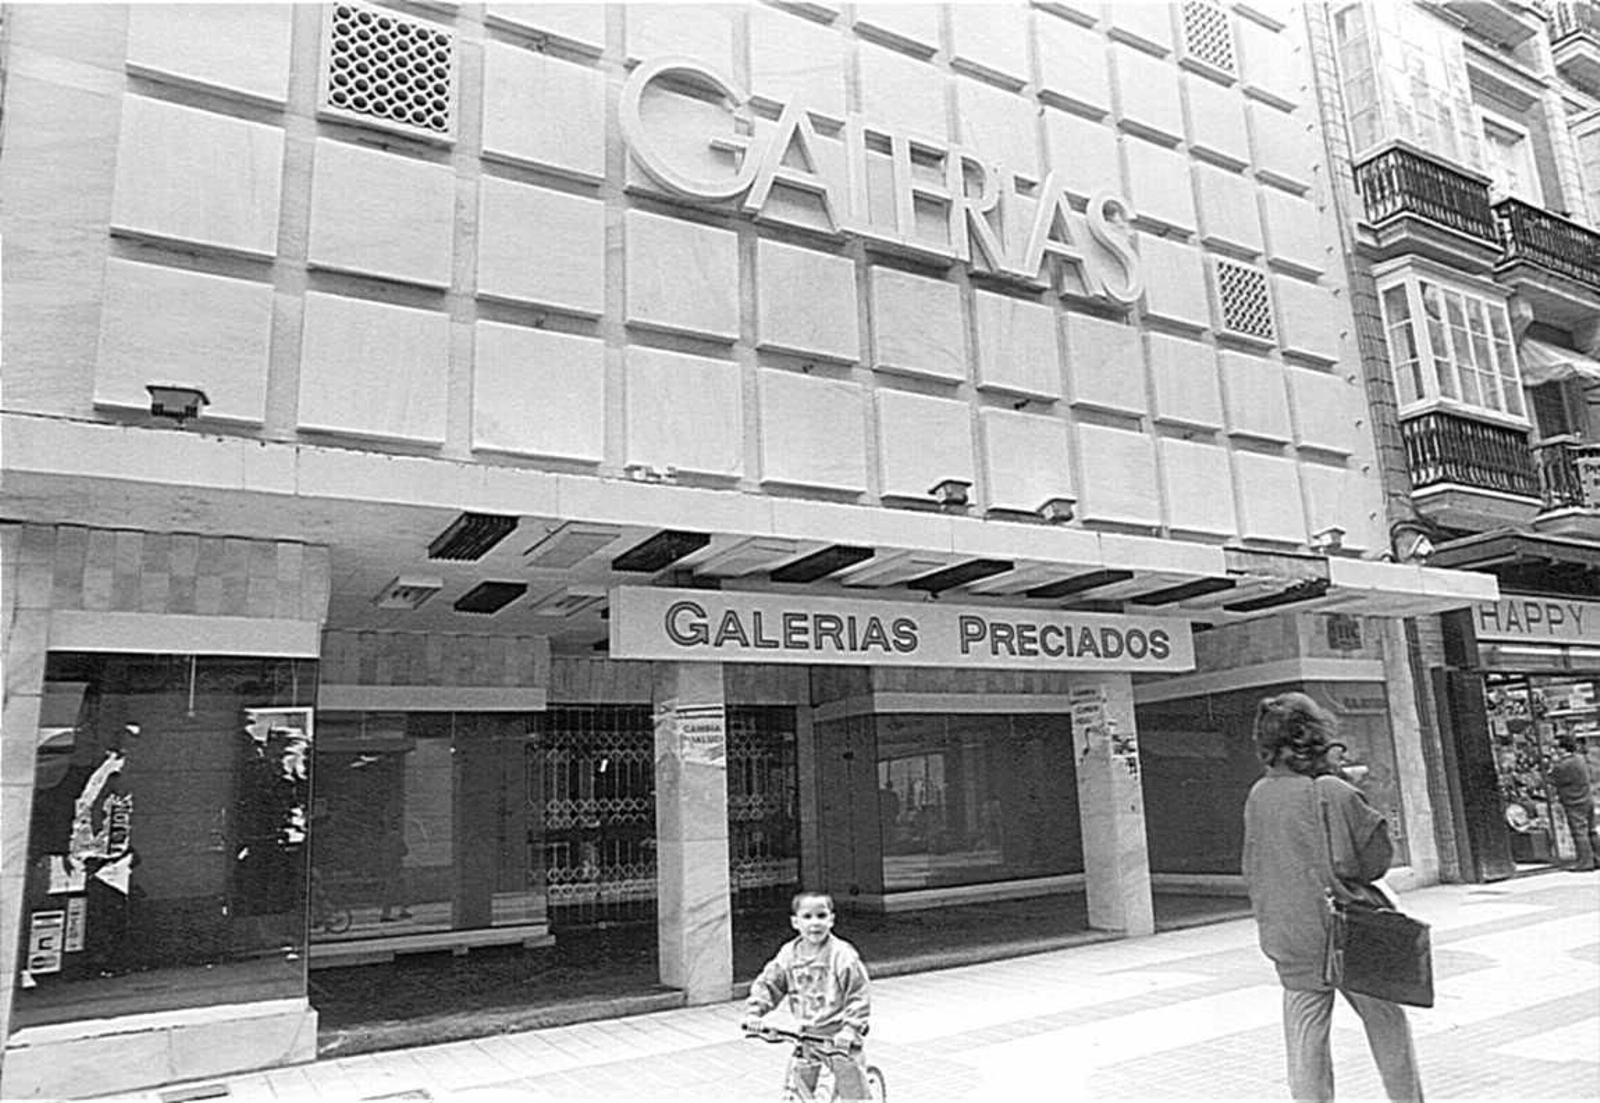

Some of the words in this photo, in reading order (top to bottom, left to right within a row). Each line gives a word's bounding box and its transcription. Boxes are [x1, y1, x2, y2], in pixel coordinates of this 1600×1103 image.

[619, 56, 1142, 303] GALERIAS
[665, 601, 918, 653] GALERIAS
[959, 615, 1170, 660] PRECIADOS
[1479, 600, 1583, 635] HAPPY
